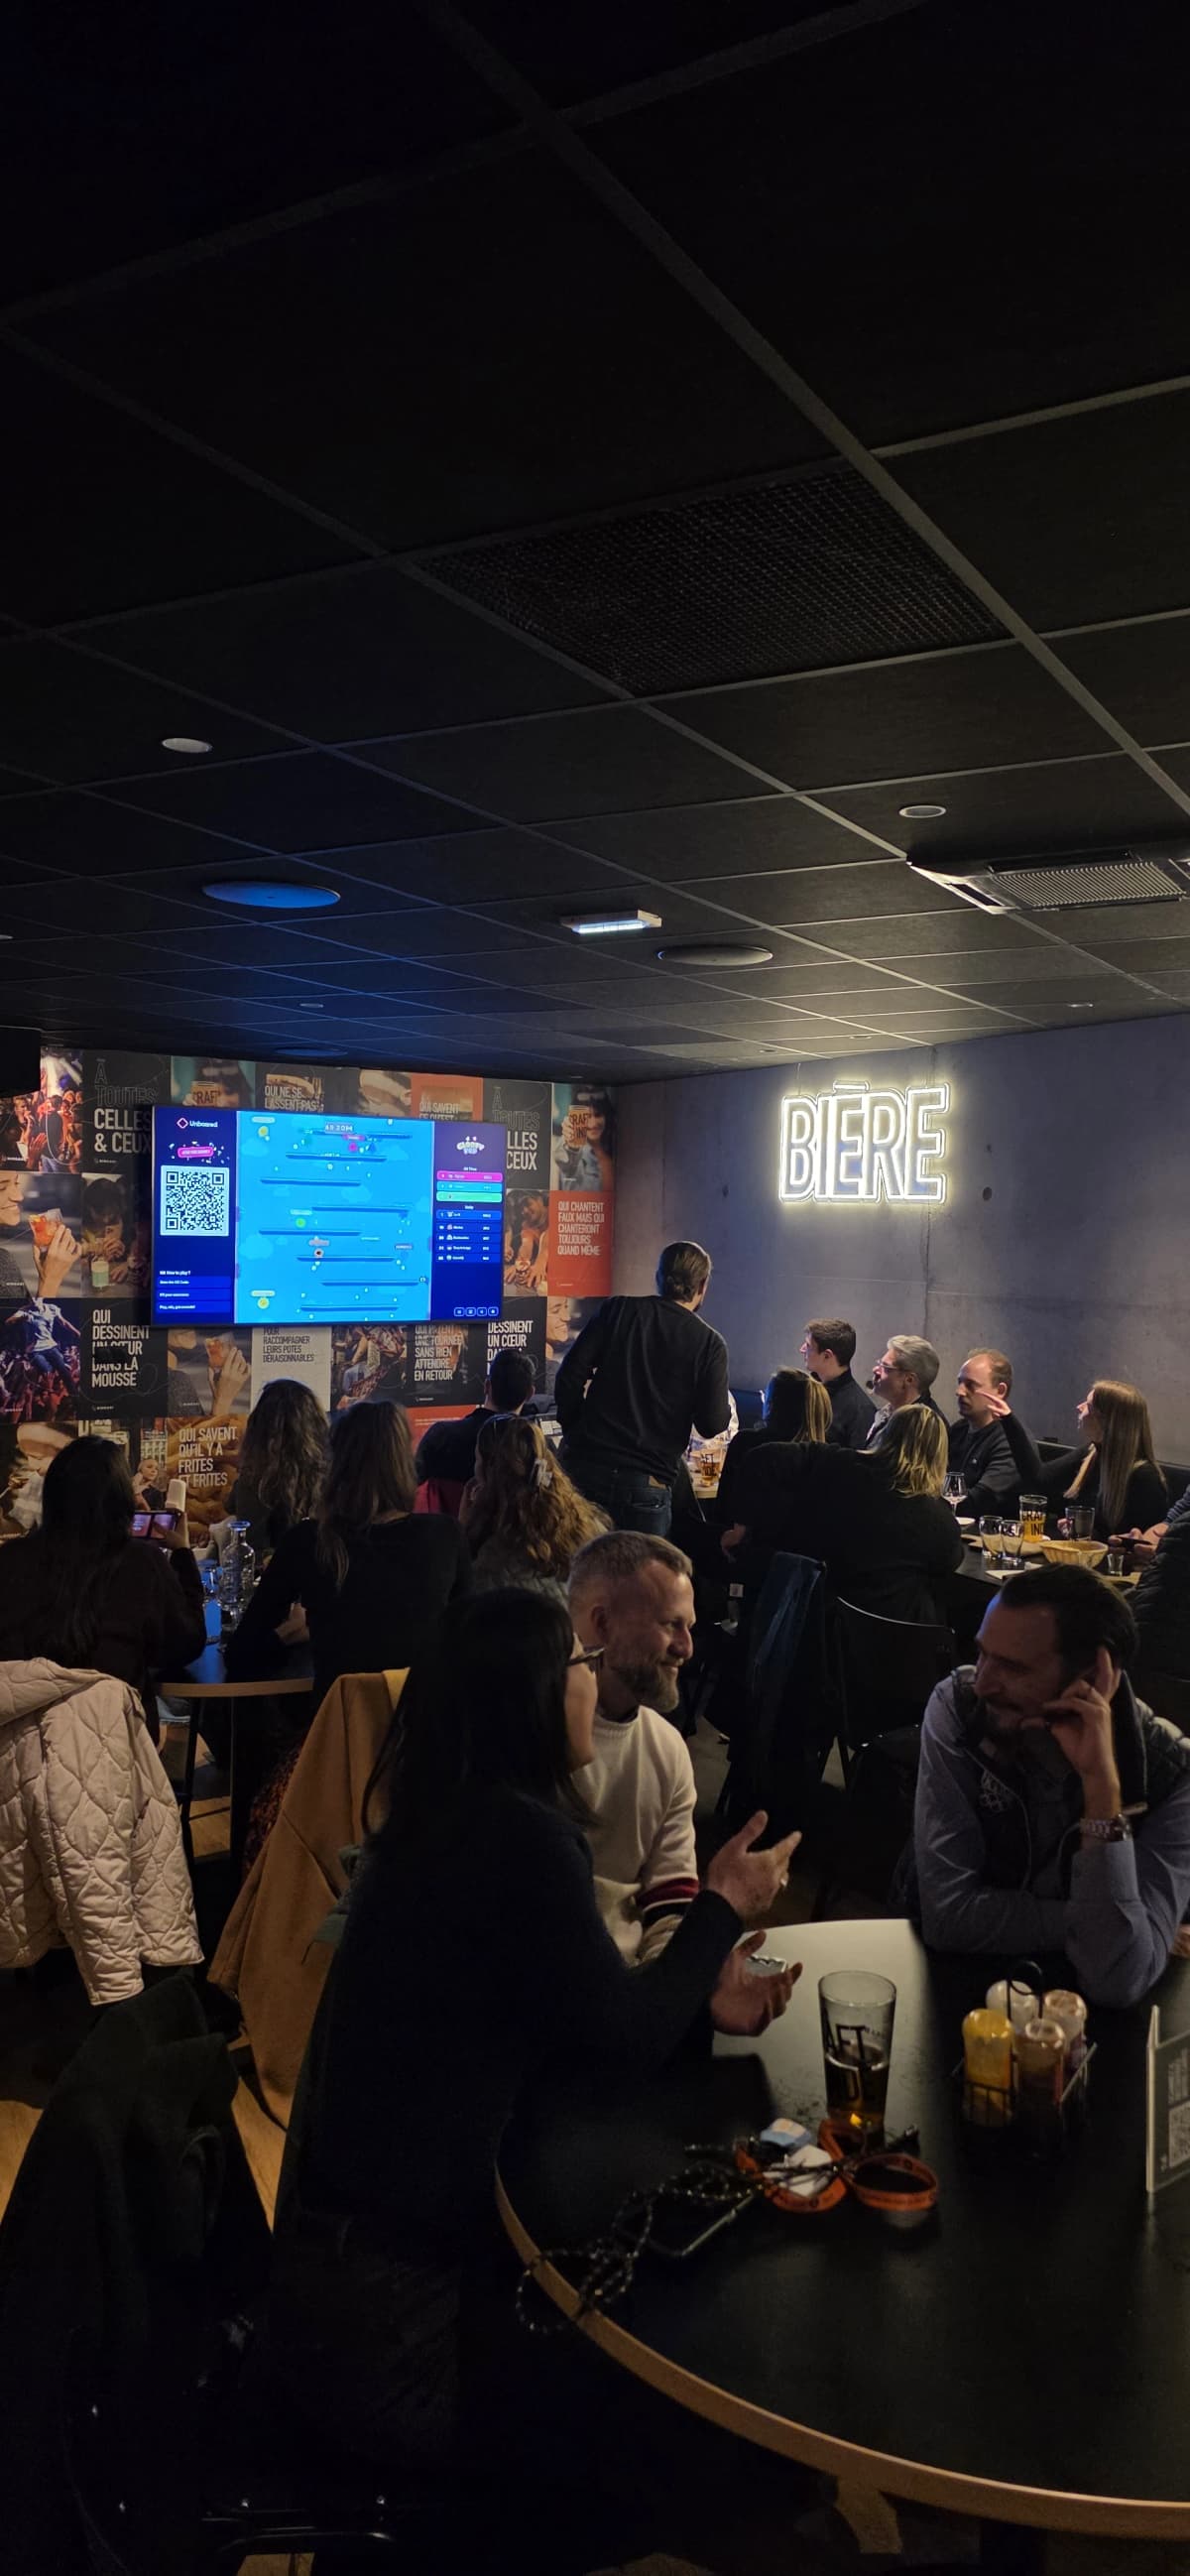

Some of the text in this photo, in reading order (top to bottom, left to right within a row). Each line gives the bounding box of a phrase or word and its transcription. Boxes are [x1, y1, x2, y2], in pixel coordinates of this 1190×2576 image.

[95, 1085, 159, 1107] TOUTES
[94, 1108, 152, 1132] CELLES
[94, 1132, 152, 1154] & CEUX
[507, 1131, 537, 1151] LLES
[507, 1151, 537, 1170] CEUX
[557, 1201, 604, 1212] QUI CHANTENT
[557, 1212, 604, 1223] FAUX MAIS QUI
[557, 1223, 600, 1234] CHANTERONT
[558, 1234, 592, 1245] TOUJOURS
[557, 1245, 579, 1256] QUAND
[92, 1308, 111, 1324] QUI
[92, 1325, 151, 1340] DESSINENT
[487, 1320, 534, 1334] DESSINENT
[263, 1336, 310, 1345] RACCOMPAGNER
[415, 1335, 428, 1346] UNE
[487, 1334, 528, 1347] UN CŒUR
[263, 1345, 301, 1354] LEURS POTES
[415, 1346, 452, 1358] SANS RIEN
[415, 1358, 452, 1369] ATTENDRE
[91, 1373, 137, 1388] MOUSSE
[414, 1369, 453, 1381] EN RETOUR
[178, 1426, 237, 1442] QUI SAVENT
[206, 1442, 214, 1456] Y
[215, 1441, 223, 1456] A
[178, 1458, 214, 1473] FRITES
[192, 1472, 228, 1487] FRITES
